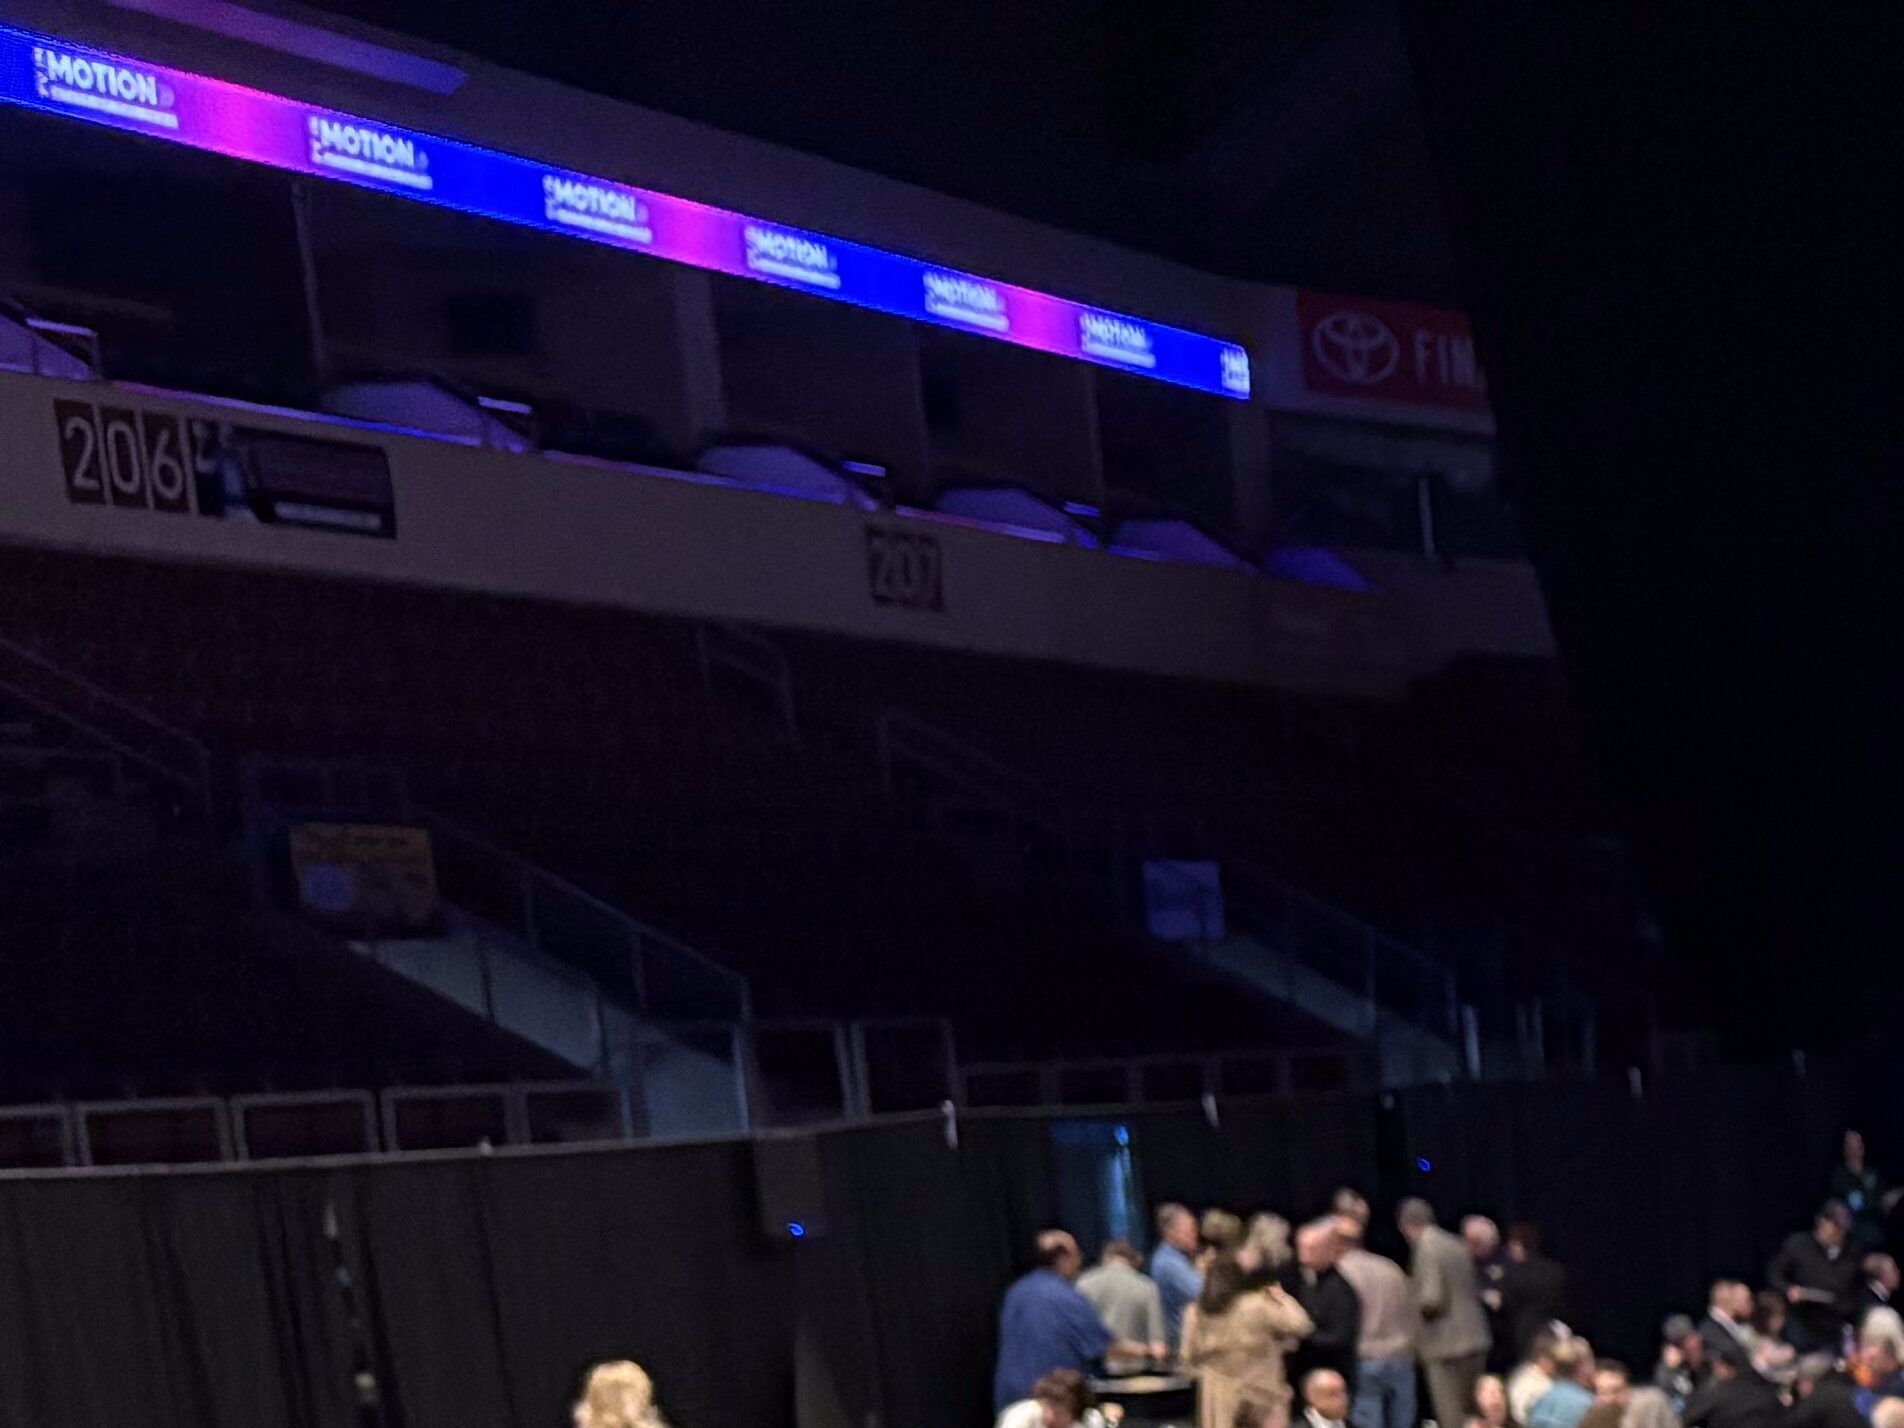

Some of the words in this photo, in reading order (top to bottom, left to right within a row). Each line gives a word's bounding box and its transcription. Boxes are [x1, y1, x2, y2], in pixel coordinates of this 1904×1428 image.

[46, 50, 158, 106] MOTION
[319, 119, 415, 168] MOTION
[555, 179, 638, 222] MOTION
[64, 415, 186, 501] 206
[871, 535, 938, 602] 207
